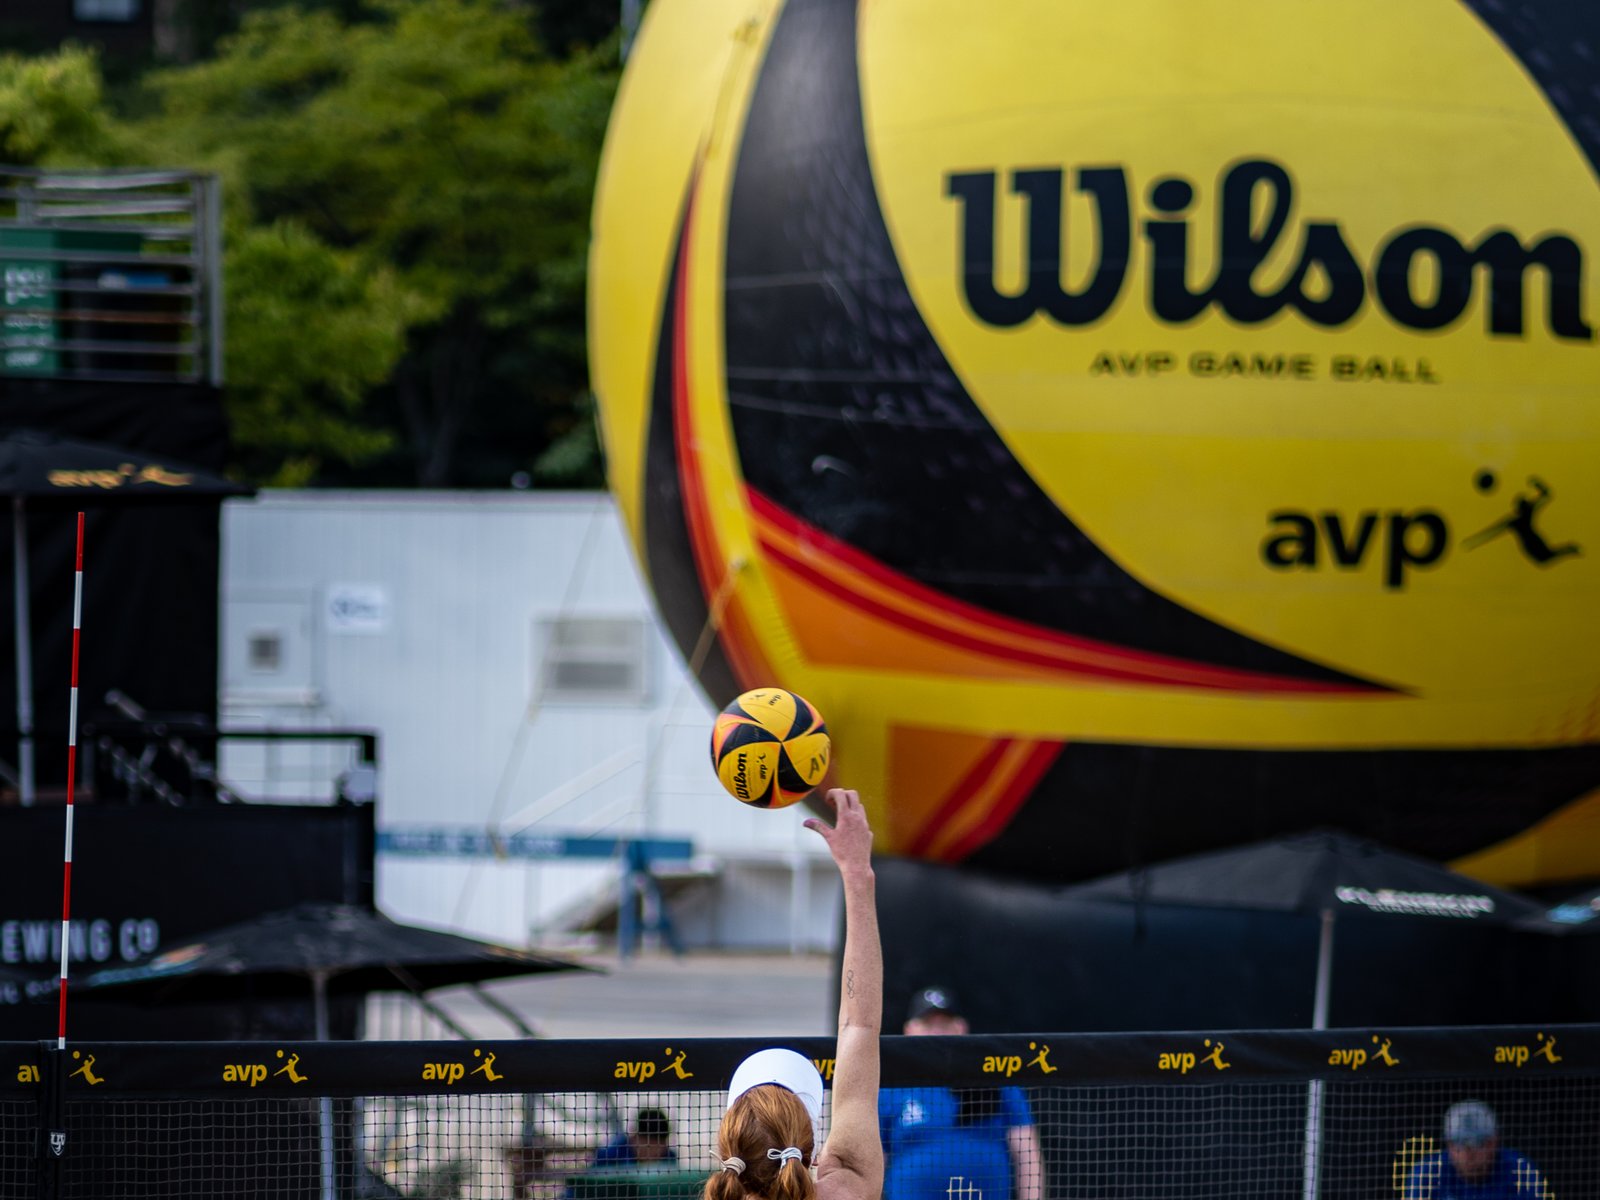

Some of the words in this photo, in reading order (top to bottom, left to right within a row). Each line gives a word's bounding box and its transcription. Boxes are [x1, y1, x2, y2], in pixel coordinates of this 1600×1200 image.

[942, 156, 1597, 346] Wilson
[1090, 351, 1178, 378] AVP
[1188, 351, 1318, 381] GAME
[1330, 354, 1442, 385] BALL
[1260, 506, 1449, 592] avp
[733, 752, 750, 799] Wilson
[17, 1064, 41, 1083] av
[222, 1064, 268, 1087] avp
[422, 1063, 465, 1085] avp
[614, 1061, 656, 1083] avp
[813, 1058, 837, 1080] vp
[982, 1055, 1022, 1078] avp
[1158, 1052, 1196, 1074] avp
[1328, 1048, 1367, 1070] avp
[1495, 1046, 1529, 1067] avp
